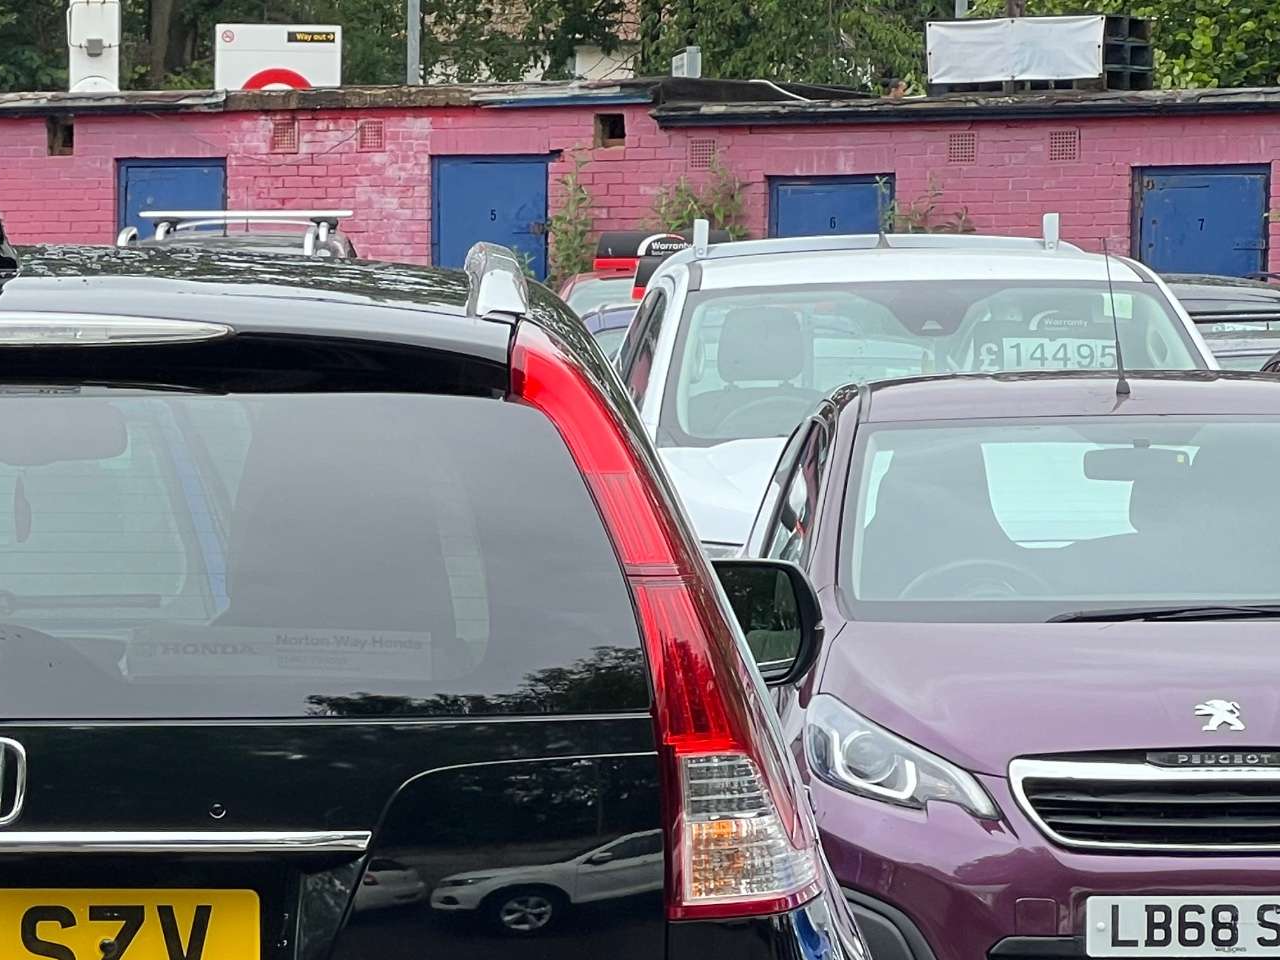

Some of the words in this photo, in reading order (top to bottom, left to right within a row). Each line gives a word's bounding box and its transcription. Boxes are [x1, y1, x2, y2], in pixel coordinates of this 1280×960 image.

[295, 32, 311, 41] Way
[490, 208, 497, 221] 5
[830, 216, 837, 229] 6
[1197, 217, 1205, 231] 7
[1044, 317, 1088, 328] Warranty
[979, 342, 1117, 371] £14495
[275, 633, 330, 647] Norton
[334, 635, 368, 650] Way
[370, 636, 424, 650] Honda
[1177, 754, 1271, 764] PEUGEOT
[1111, 904, 1239, 947] LB68
